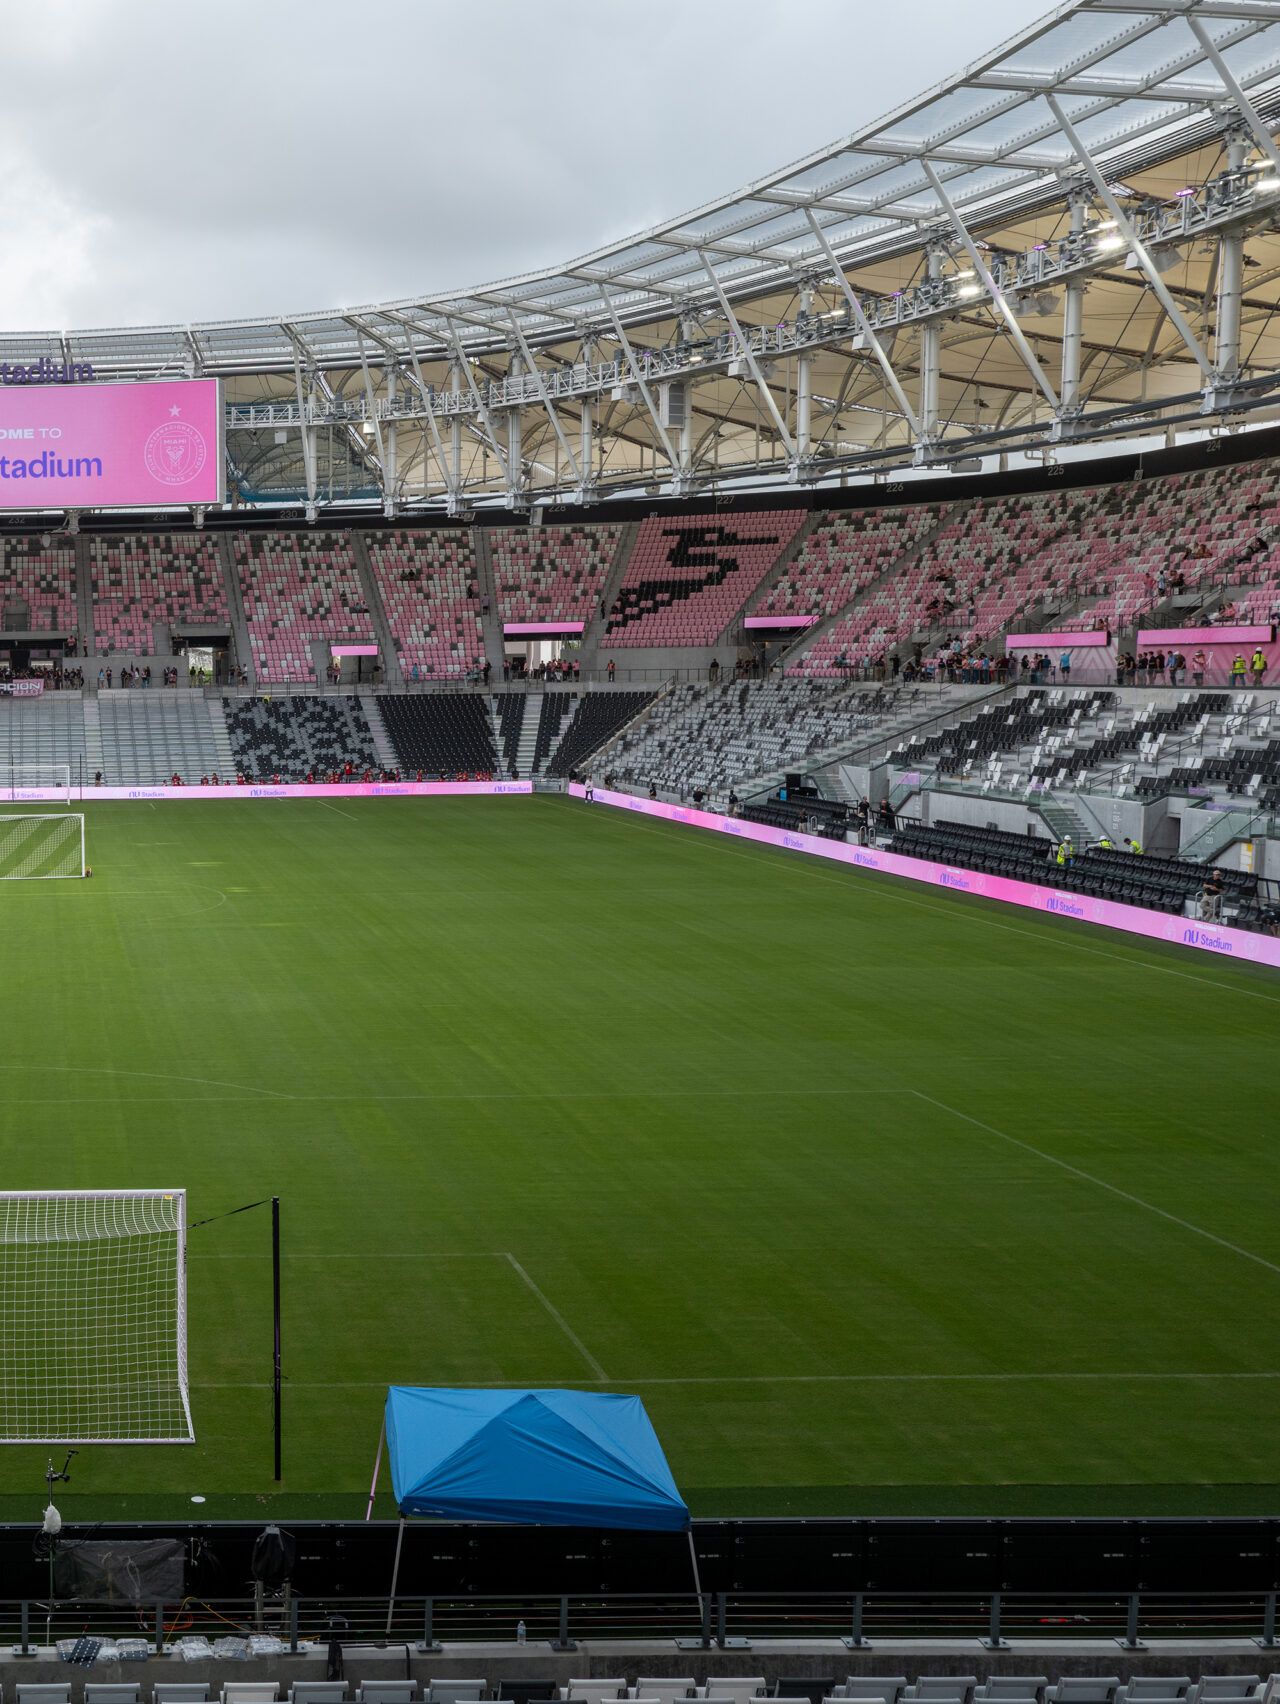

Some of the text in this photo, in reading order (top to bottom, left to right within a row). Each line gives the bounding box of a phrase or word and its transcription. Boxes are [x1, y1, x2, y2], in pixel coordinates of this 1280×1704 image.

[39, 427, 62, 439] TO
[1207, 441, 1221, 452] 224
[1048, 466, 1065, 476] 225
[886, 483, 904, 493] 226
[717, 496, 735, 505] 227
[280, 511, 299, 519] 230
[950, 875, 970, 889] Stadium
[1059, 901, 1084, 916] Stadium
[1201, 934, 1233, 952] Stadium
